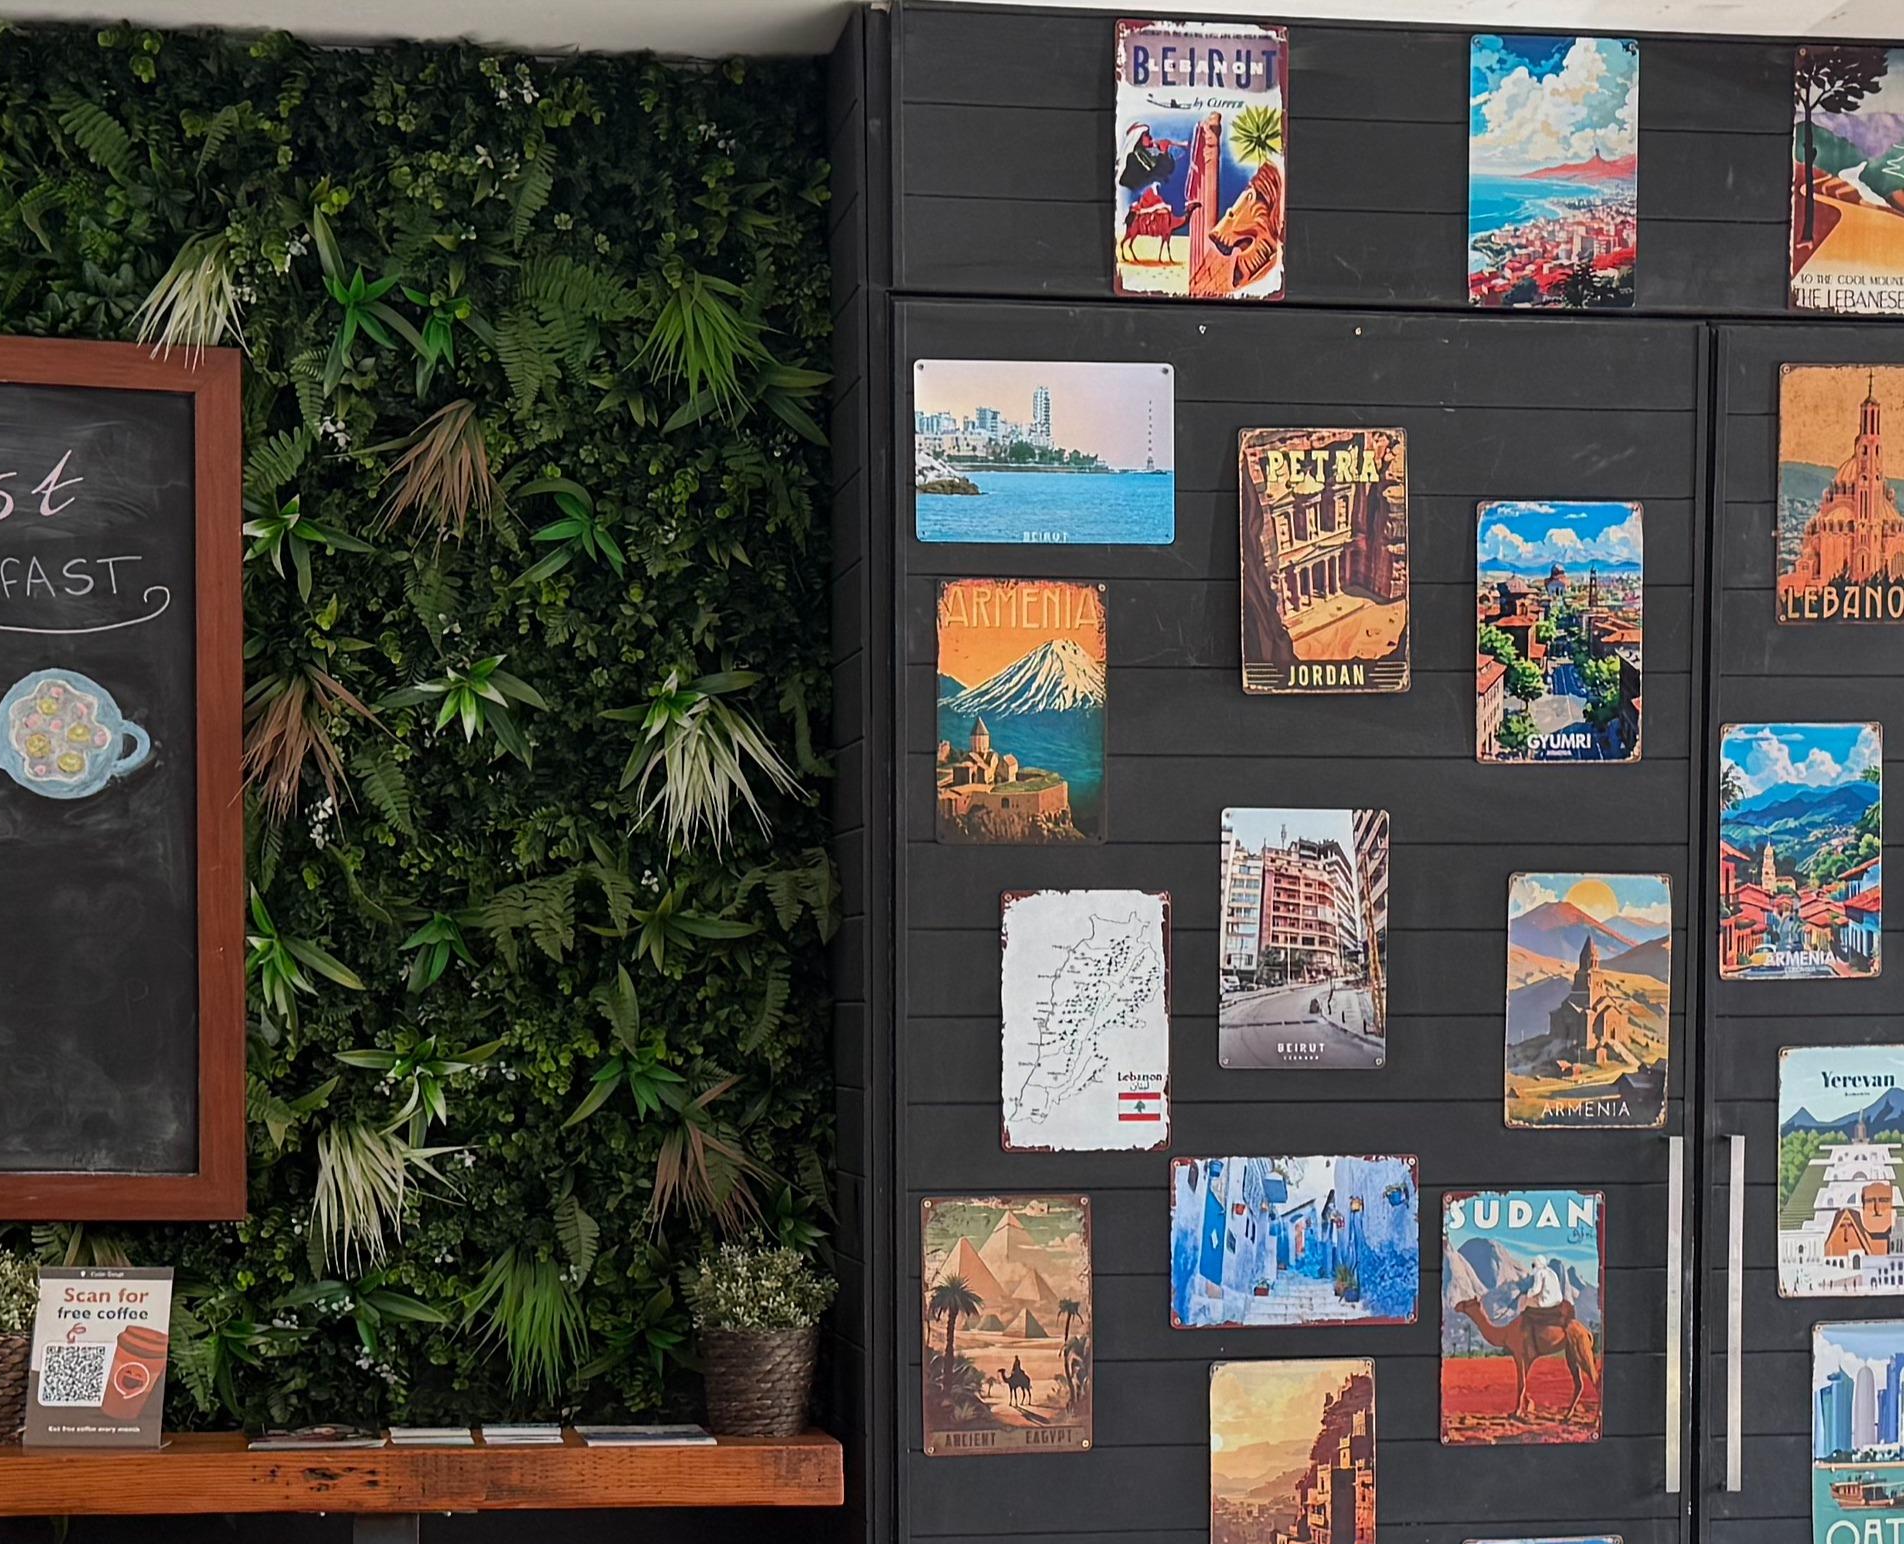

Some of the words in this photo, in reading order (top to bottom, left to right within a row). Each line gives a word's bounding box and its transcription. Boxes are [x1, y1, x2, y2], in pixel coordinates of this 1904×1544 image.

[1133, 45, 1277, 89] BEIRUT
[1148, 58, 1264, 75] LEBANON
[1817, 274, 1831, 284] THE
[1837, 274, 1866, 286] COOL
[1795, 287, 1822, 309] THE
[1267, 449, 1379, 484] PETRA
[945, 588, 1099, 630] ARMENIA
[1287, 664, 1366, 687] JORDAN
[1527, 732, 1591, 749] GYUMRI
[1765, 950, 1836, 967] ARMENIA
[1277, 1042, 1325, 1053] BEIRUT
[1117, 1072, 1163, 1082] Lebanon
[1821, 1070, 1895, 1089] Yerevan
[1541, 1101, 1631, 1118] ARMENIA
[1449, 1198, 1594, 1230] SUDAN
[64, 1287, 111, 1304] Scan
[118, 1288, 149, 1304] for
[57, 1307, 91, 1320] free
[97, 1307, 148, 1320] coffee
[945, 1431, 996, 1447] ANCIENT
